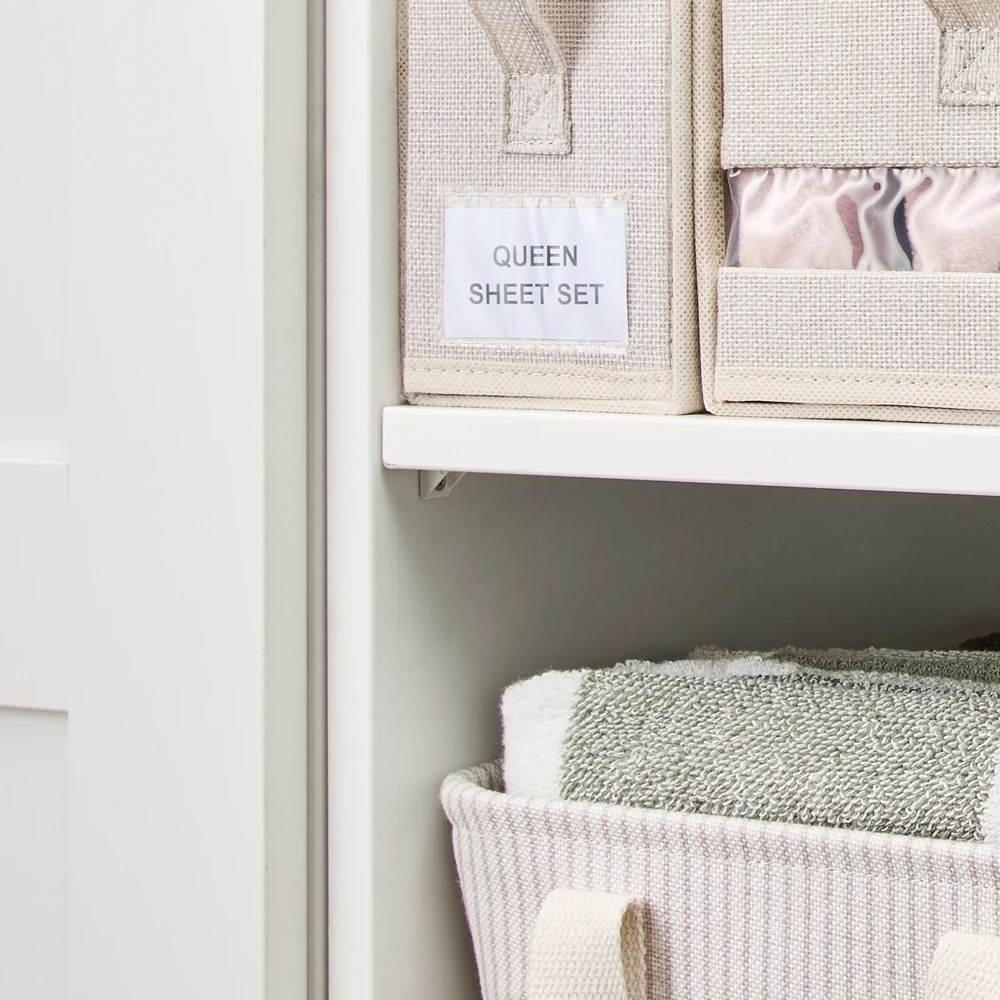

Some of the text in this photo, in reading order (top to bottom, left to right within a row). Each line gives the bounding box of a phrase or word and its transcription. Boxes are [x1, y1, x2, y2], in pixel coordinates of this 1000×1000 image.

[493, 245, 578, 268] QUEEN
[469, 283, 604, 305] SHEET SET
